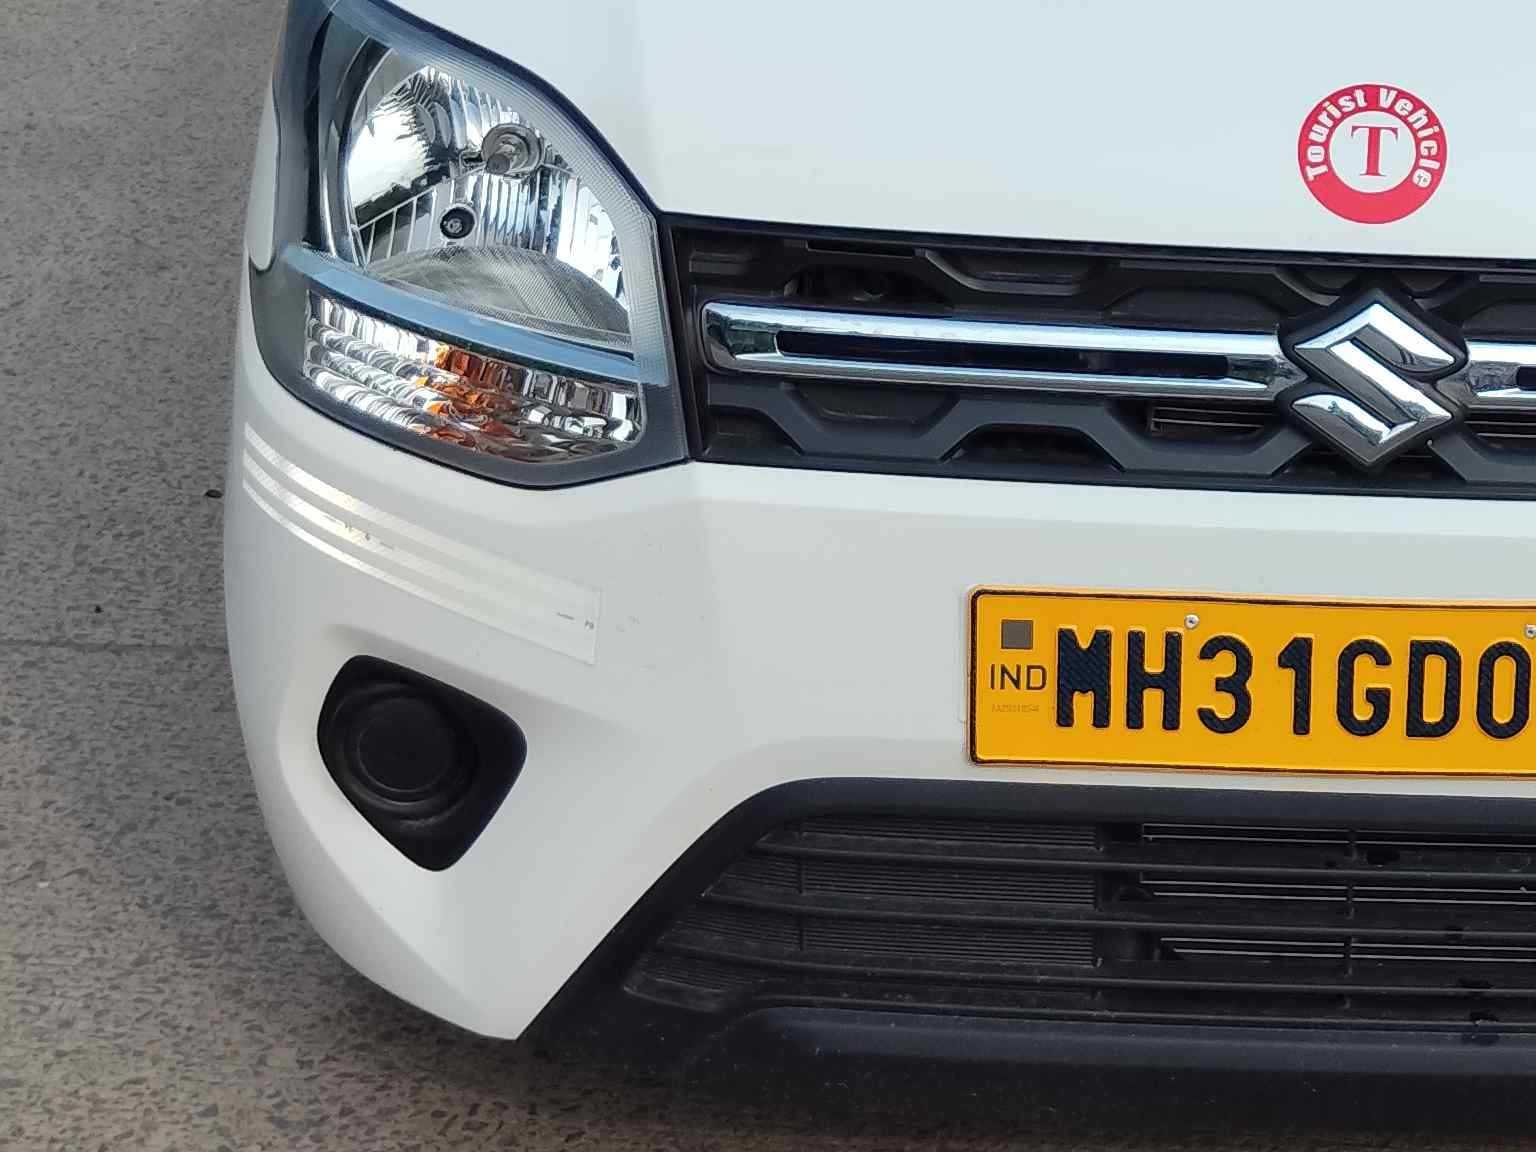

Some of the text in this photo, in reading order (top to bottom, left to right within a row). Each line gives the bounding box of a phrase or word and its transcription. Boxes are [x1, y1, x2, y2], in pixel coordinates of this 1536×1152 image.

[1305, 87, 1441, 188] Tourist Vehicle
[1350, 124, 1399, 177] T
[989, 663, 1048, 691] IND
